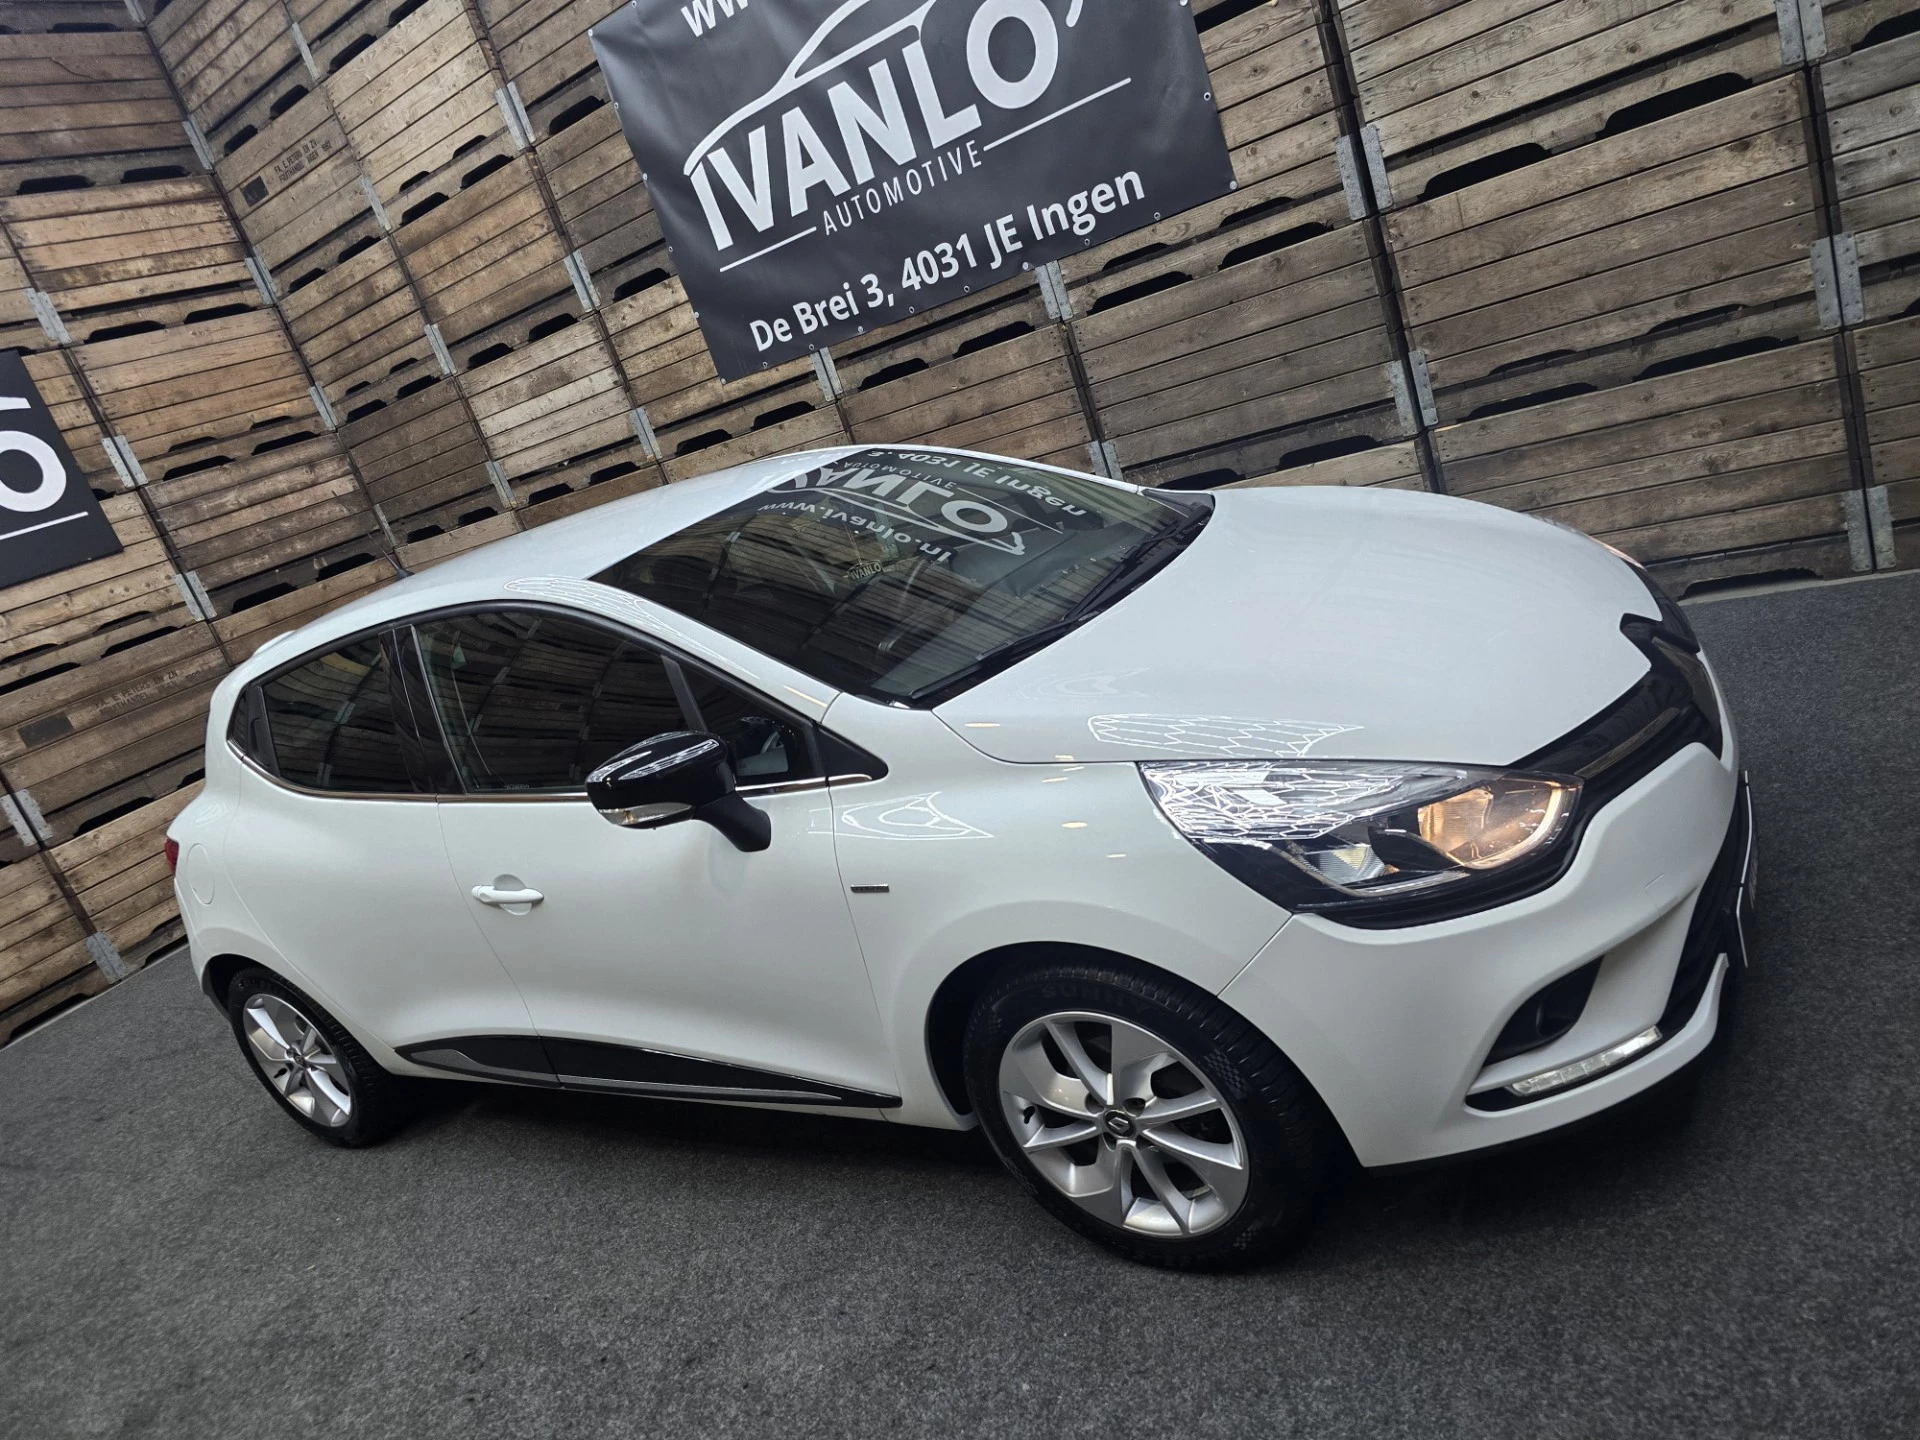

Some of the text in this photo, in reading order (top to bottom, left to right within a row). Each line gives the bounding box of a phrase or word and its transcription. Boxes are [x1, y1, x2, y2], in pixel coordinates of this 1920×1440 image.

[691, 0, 1058, 250] IVANLO
[824, 140, 981, 235] AUTOMOTIVE
[750, 172, 1144, 351] De Brei 3, 4031 JE Ingen
